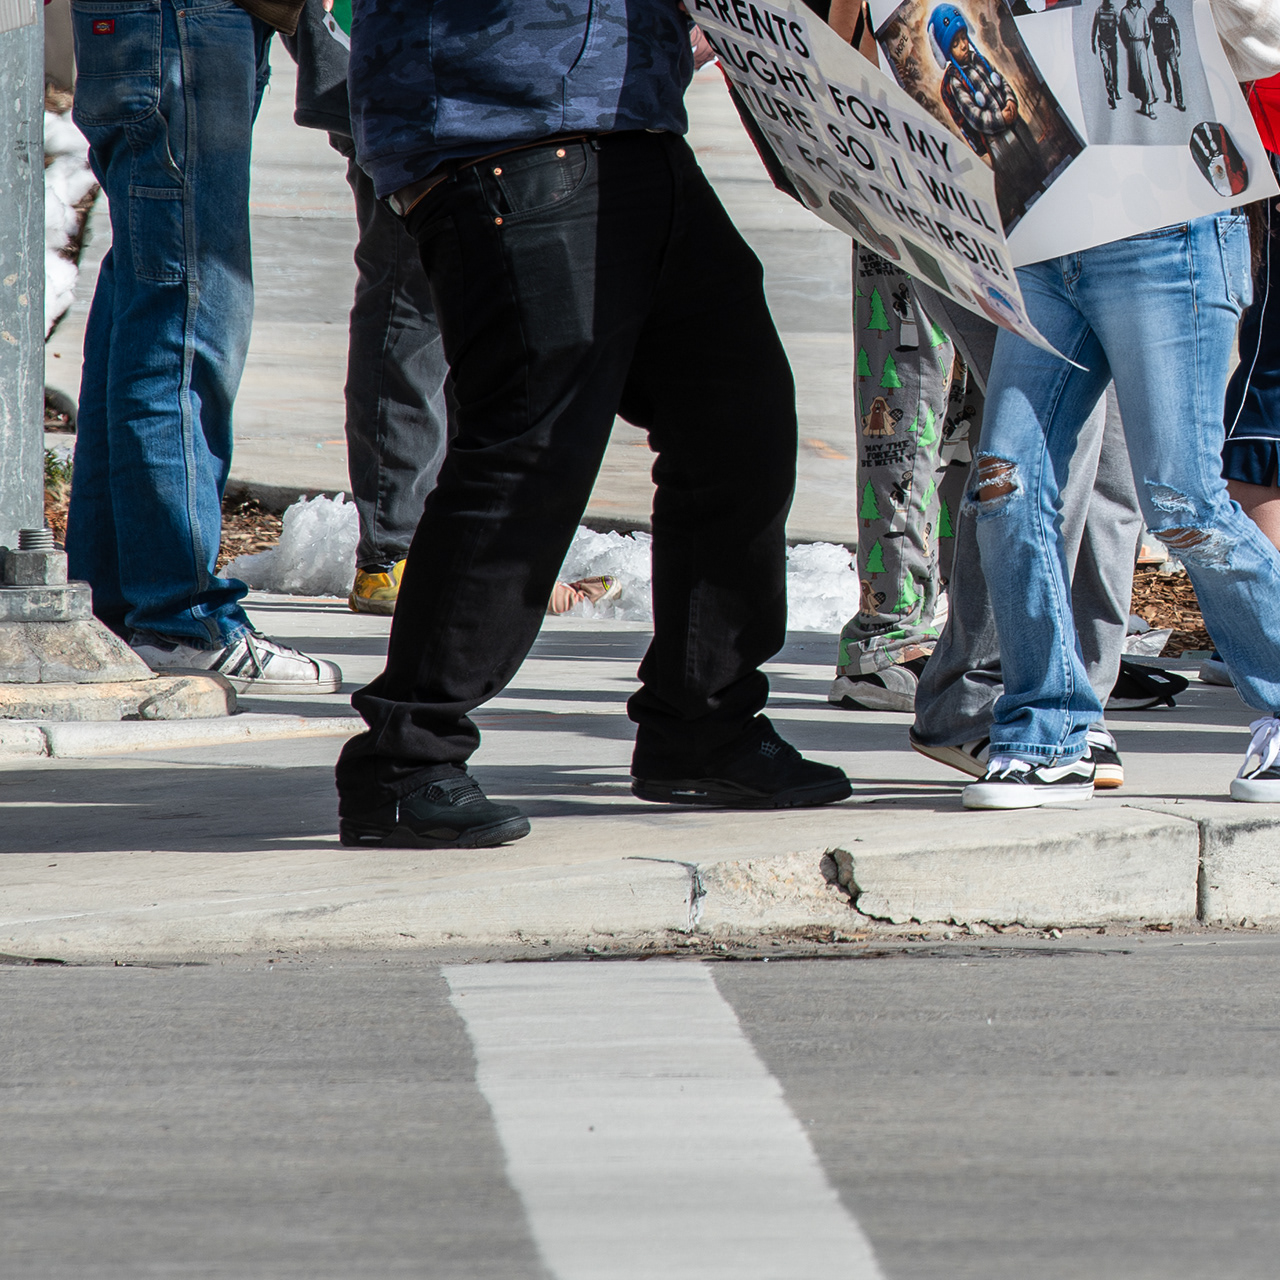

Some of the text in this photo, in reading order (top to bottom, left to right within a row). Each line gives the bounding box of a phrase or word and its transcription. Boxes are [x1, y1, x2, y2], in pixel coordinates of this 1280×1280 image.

[1155, 16, 1169, 25] POLICE
[894, 33, 909, 58] HOPE
[828, 83, 900, 144] FOR
[903, 121, 953, 173] MY
[828, 122, 875, 170] SO
[891, 156, 908, 190] I
[917, 169, 997, 234] WILL
[797, 144, 872, 204] FOR
[869, 184, 1009, 281] THEIRS!!!
[865, 440, 910, 452] MAY THE
[866, 448, 905, 460] FOREST
[861, 459, 872, 467] BE
